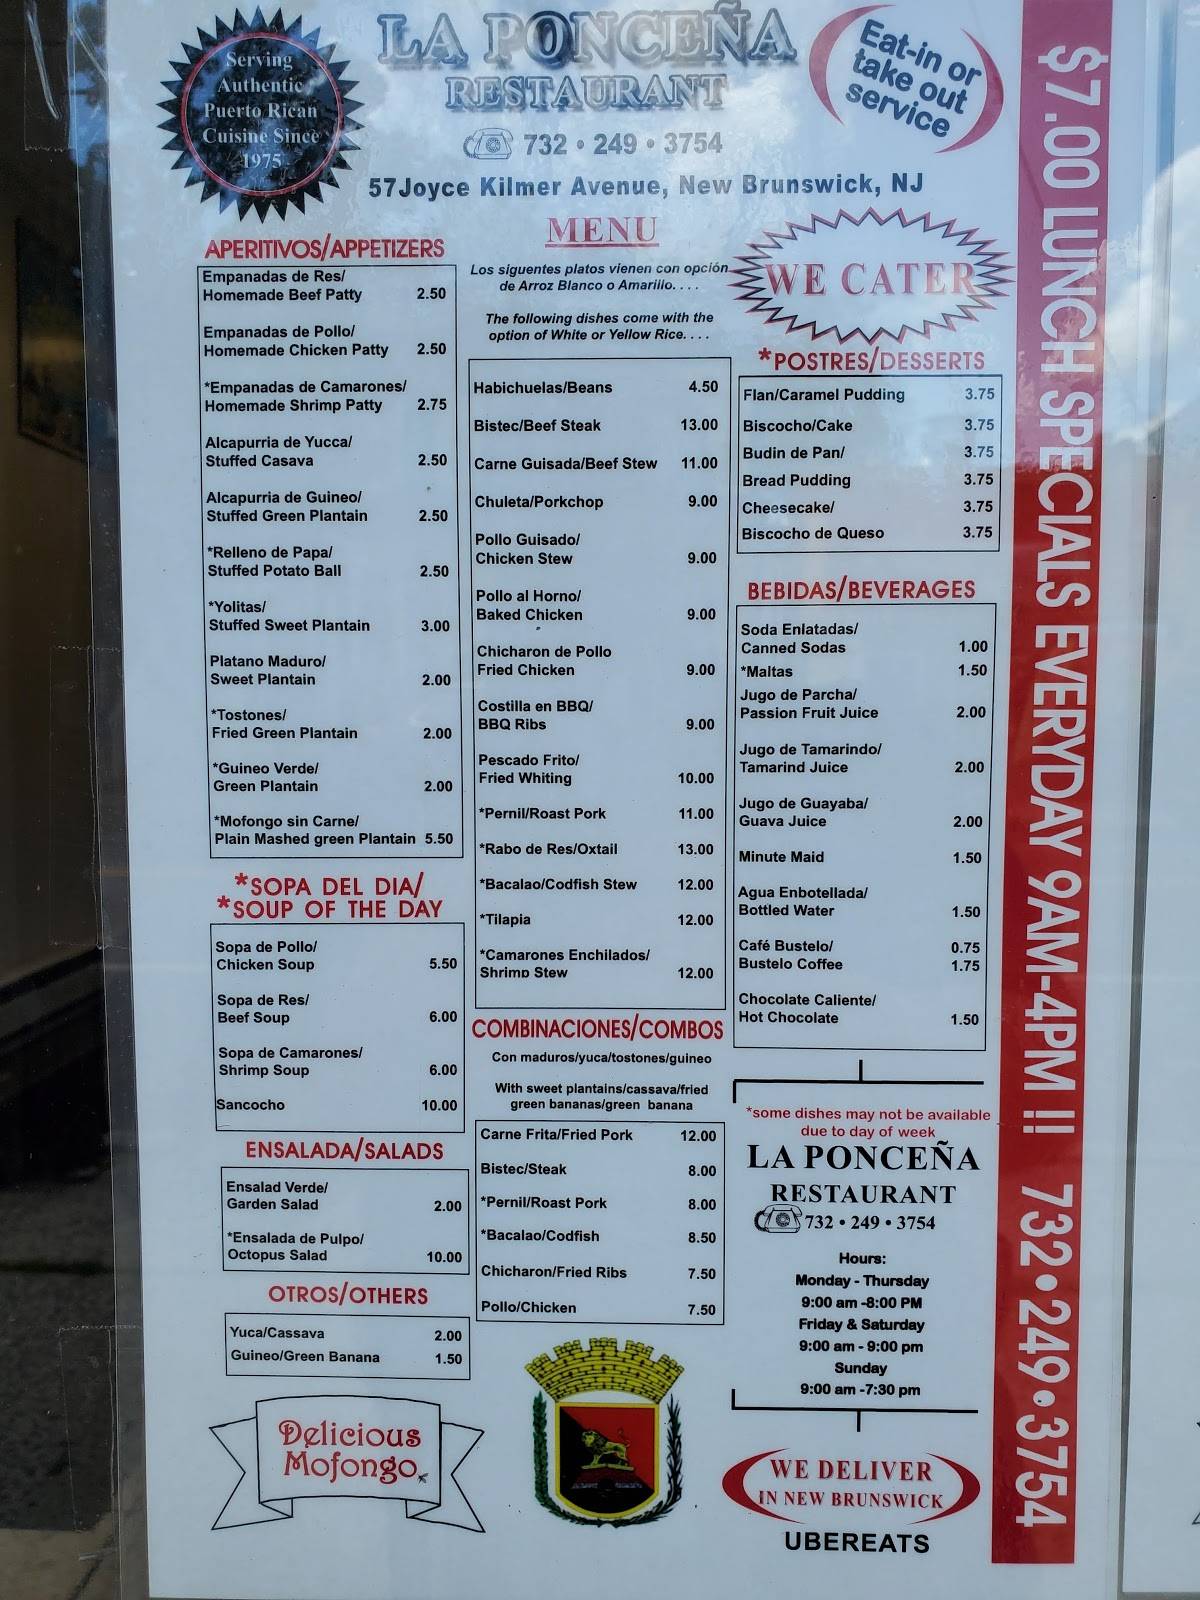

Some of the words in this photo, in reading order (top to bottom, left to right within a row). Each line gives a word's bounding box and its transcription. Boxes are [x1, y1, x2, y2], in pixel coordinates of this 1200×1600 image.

[377, 12, 469, 68] LA
[483, 0, 798, 68] PONCEÑA
[860, 19, 942, 73] Eat-in
[948, 62, 982, 86] or
[226, 51, 292, 71] Serving
[218, 77, 303, 92] Authentic
[852, 48, 914, 92] take
[919, 82, 968, 114] out
[445, 73, 728, 112] RESTAURANT
[204, 102, 262, 118] Puerto
[268, 102, 318, 118] Rican
[845, 83, 950, 138] service
[1038, 46, 1108, 189] $7.00
[202, 128, 268, 144] Cuisine
[273, 128, 320, 144] Since
[524, 134, 567, 155] 732
[594, 133, 637, 154] 249
[664, 132, 722, 154] 3754
[242, 154, 282, 168] 1975
[369, 178, 469, 202] 57Joyce
[481, 177, 561, 196] Kilmer
[571, 177, 667, 199] Avenue,
[680, 175, 732, 194] New
[743, 174, 880, 197] Brunswick,
[892, 173, 921, 192] NJ
[548, 217, 656, 242] MENU
[205, 233, 444, 261] APERITIVOS/APPETIZERS
[765, 264, 825, 295] WE
[842, 262, 978, 294] CATER
[204, 289, 284, 301] Homemade
[289, 289, 321, 300] Beef
[326, 289, 362, 303] Patty
[417, 287, 446, 299] 2.50
[1041, 207, 1099, 373] LUNCH
[486, 313, 509, 324] The
[513, 313, 572, 326] following
[576, 313, 618, 323] dishes
[623, 315, 658, 323] come
[663, 312, 689, 323] with
[694, 312, 713, 322] the
[205, 344, 284, 356] Homemade
[290, 344, 347, 356] Chicken
[353, 344, 388, 358] Patty
[417, 343, 446, 354] 2.50
[474, 381, 612, 394] Habichuelas/Beans
[689, 381, 718, 392] 4.50
[744, 389, 839, 401] Flan/Caramel
[845, 388, 904, 403] Pudding
[965, 388, 994, 400] 3.75
[475, 419, 557, 432] Bistec/Beef
[561, 419, 601, 431] Steak
[681, 419, 718, 431] 13.00
[744, 419, 852, 432] Biscocho/Cake
[965, 419, 994, 431] 3.75
[743, 474, 785, 486] Bread
[791, 474, 850, 488] Pudding
[964, 473, 993, 485] 3.75
[475, 496, 603, 510] Chuleta/Porkchop
[689, 495, 717, 507] 9.00
[1036, 390, 1094, 608] SPECIALS
[749, 575, 975, 602] BEBIDAS/BEVERAGES
[477, 608, 520, 620] Baked
[526, 609, 582, 620] Chicken
[688, 608, 716, 620] 9.00
[209, 619, 259, 631] Stuffed
[265, 619, 308, 631] Sweet
[313, 619, 370, 631] Plantain
[422, 620, 450, 632] 3.00
[742, 642, 795, 654] Canned
[801, 642, 845, 653] Sodas
[960, 641, 988, 652] 1.00
[959, 664, 987, 676] 1.50
[213, 727, 247, 738] Fried
[253, 727, 295, 738] Green
[300, 727, 357, 738] Plantain
[424, 728, 452, 739] 2.00
[1029, 624, 1089, 856] EVERYDAY
[740, 851, 786, 862] Minute
[791, 851, 824, 862] Maid
[954, 852, 981, 863] 1.50
[323, 878, 363, 895] DEL
[376, 872, 424, 898] DIA/
[305, 900, 335, 918] OF
[348, 900, 385, 918] THE
[400, 900, 442, 917] DAY
[678, 914, 713, 925] 12.00
[739, 940, 770, 951] Café
[775, 940, 833, 952] Bustelo/
[952, 942, 980, 953] 0.75
[217, 959, 273, 970] Chicken
[278, 959, 314, 972] Soup
[430, 958, 457, 969] 5.50
[1023, 869, 1082, 1091] 9AM-4PM
[739, 1011, 763, 1022] Hot
[768, 1011, 838, 1023] Chocolate
[952, 1014, 979, 1025] 1.50
[472, 1013, 723, 1041] COMBINACIONES/COMBOS
[495, 1083, 522, 1093] With
[527, 1084, 562, 1093] sweet
[567, 1083, 708, 1096] plantains/cassava/fried
[795, 1108, 841, 1119] dishes
[847, 1111, 874, 1122] may
[880, 1109, 902, 1119] not
[907, 1109, 923, 1120] be
[928, 1109, 990, 1120] available
[1023, 1110, 1075, 1133] !!
[247, 1137, 443, 1162] ENSALADA/SALADS
[747, 1145, 795, 1168] LA
[804, 1140, 980, 1170] PONCEÑA
[481, 1163, 566, 1174] Bistec/Steak
[689, 1165, 716, 1176] 8.00
[771, 1184, 956, 1203] RESTAURANT
[227, 1198, 276, 1209] Garden
[281, 1199, 318, 1210] Salad
[434, 1201, 461, 1211] 2.00
[805, 1215, 833, 1229] 732
[851, 1216, 879, 1229] 249
[897, 1216, 935, 1229] 3754
[689, 1232, 716, 1243] 8.50
[840, 1252, 886, 1264] Hours:
[269, 1282, 427, 1305] OTROS/OTHERS
[482, 1301, 576, 1313] Pollo/Chicken
[688, 1304, 715, 1315] 7.50
[802, 1296, 832, 1308] 9:00
[836, 1300, 857, 1308] am
[861, 1297, 897, 1308] -8:00
[901, 1297, 922, 1308] PM
[230, 1326, 324, 1338] Yuca/Cassava
[435, 1330, 462, 1341] 2.00
[799, 1318, 843, 1332] Friday
[847, 1319, 857, 1330] &
[862, 1319, 925, 1333] Saturday
[835, 1362, 887, 1376] Sunday
[279, 1420, 421, 1448] Delicious
[284, 1451, 417, 1484] Mofongo
[770, 1460, 808, 1479] WE
[819, 1460, 931, 1481] DELIVER
[759, 1491, 776, 1504] IN
[785, 1492, 824, 1505] NEW
[832, 1493, 942, 1508] BRUNSWICK
[786, 1532, 929, 1553] UBEREATS
